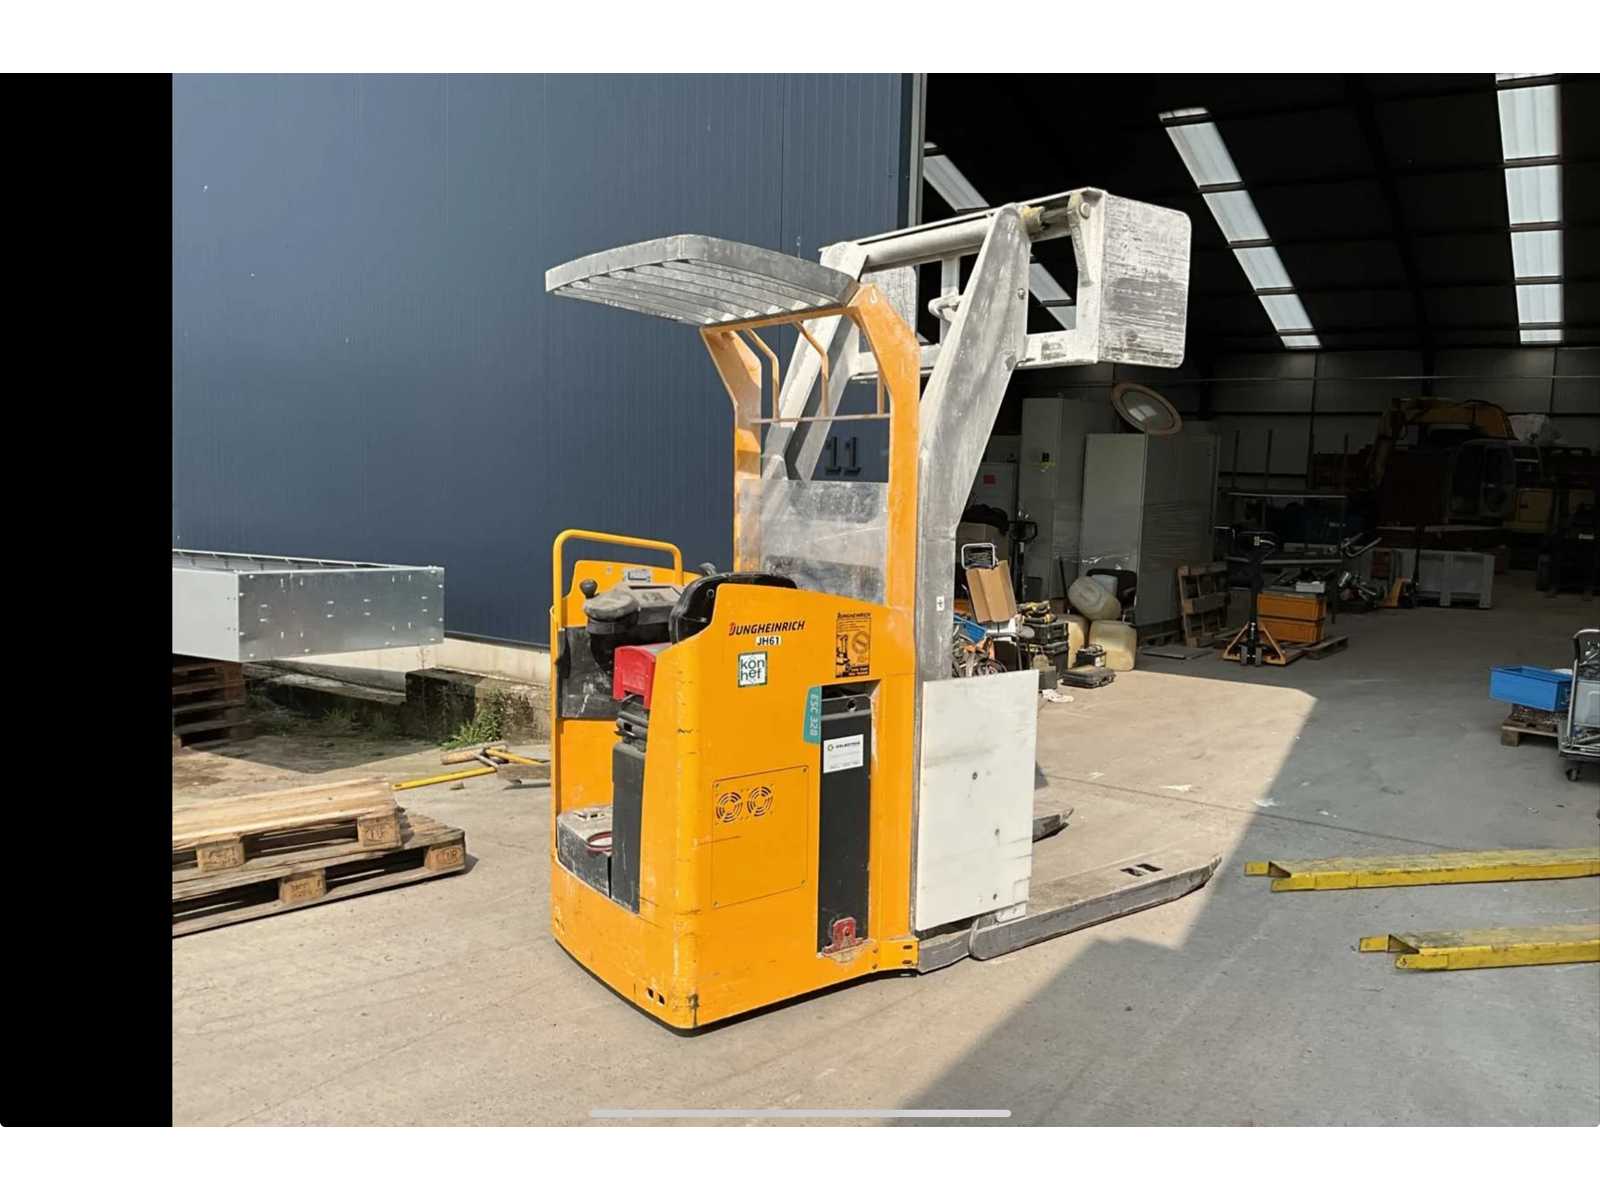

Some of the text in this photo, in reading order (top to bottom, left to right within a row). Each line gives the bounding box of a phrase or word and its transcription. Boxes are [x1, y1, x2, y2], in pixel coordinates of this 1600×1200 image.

[825, 436, 862, 475] 11
[728, 620, 806, 637] JUNGHEINRICH
[757, 636, 780, 646] JH61
